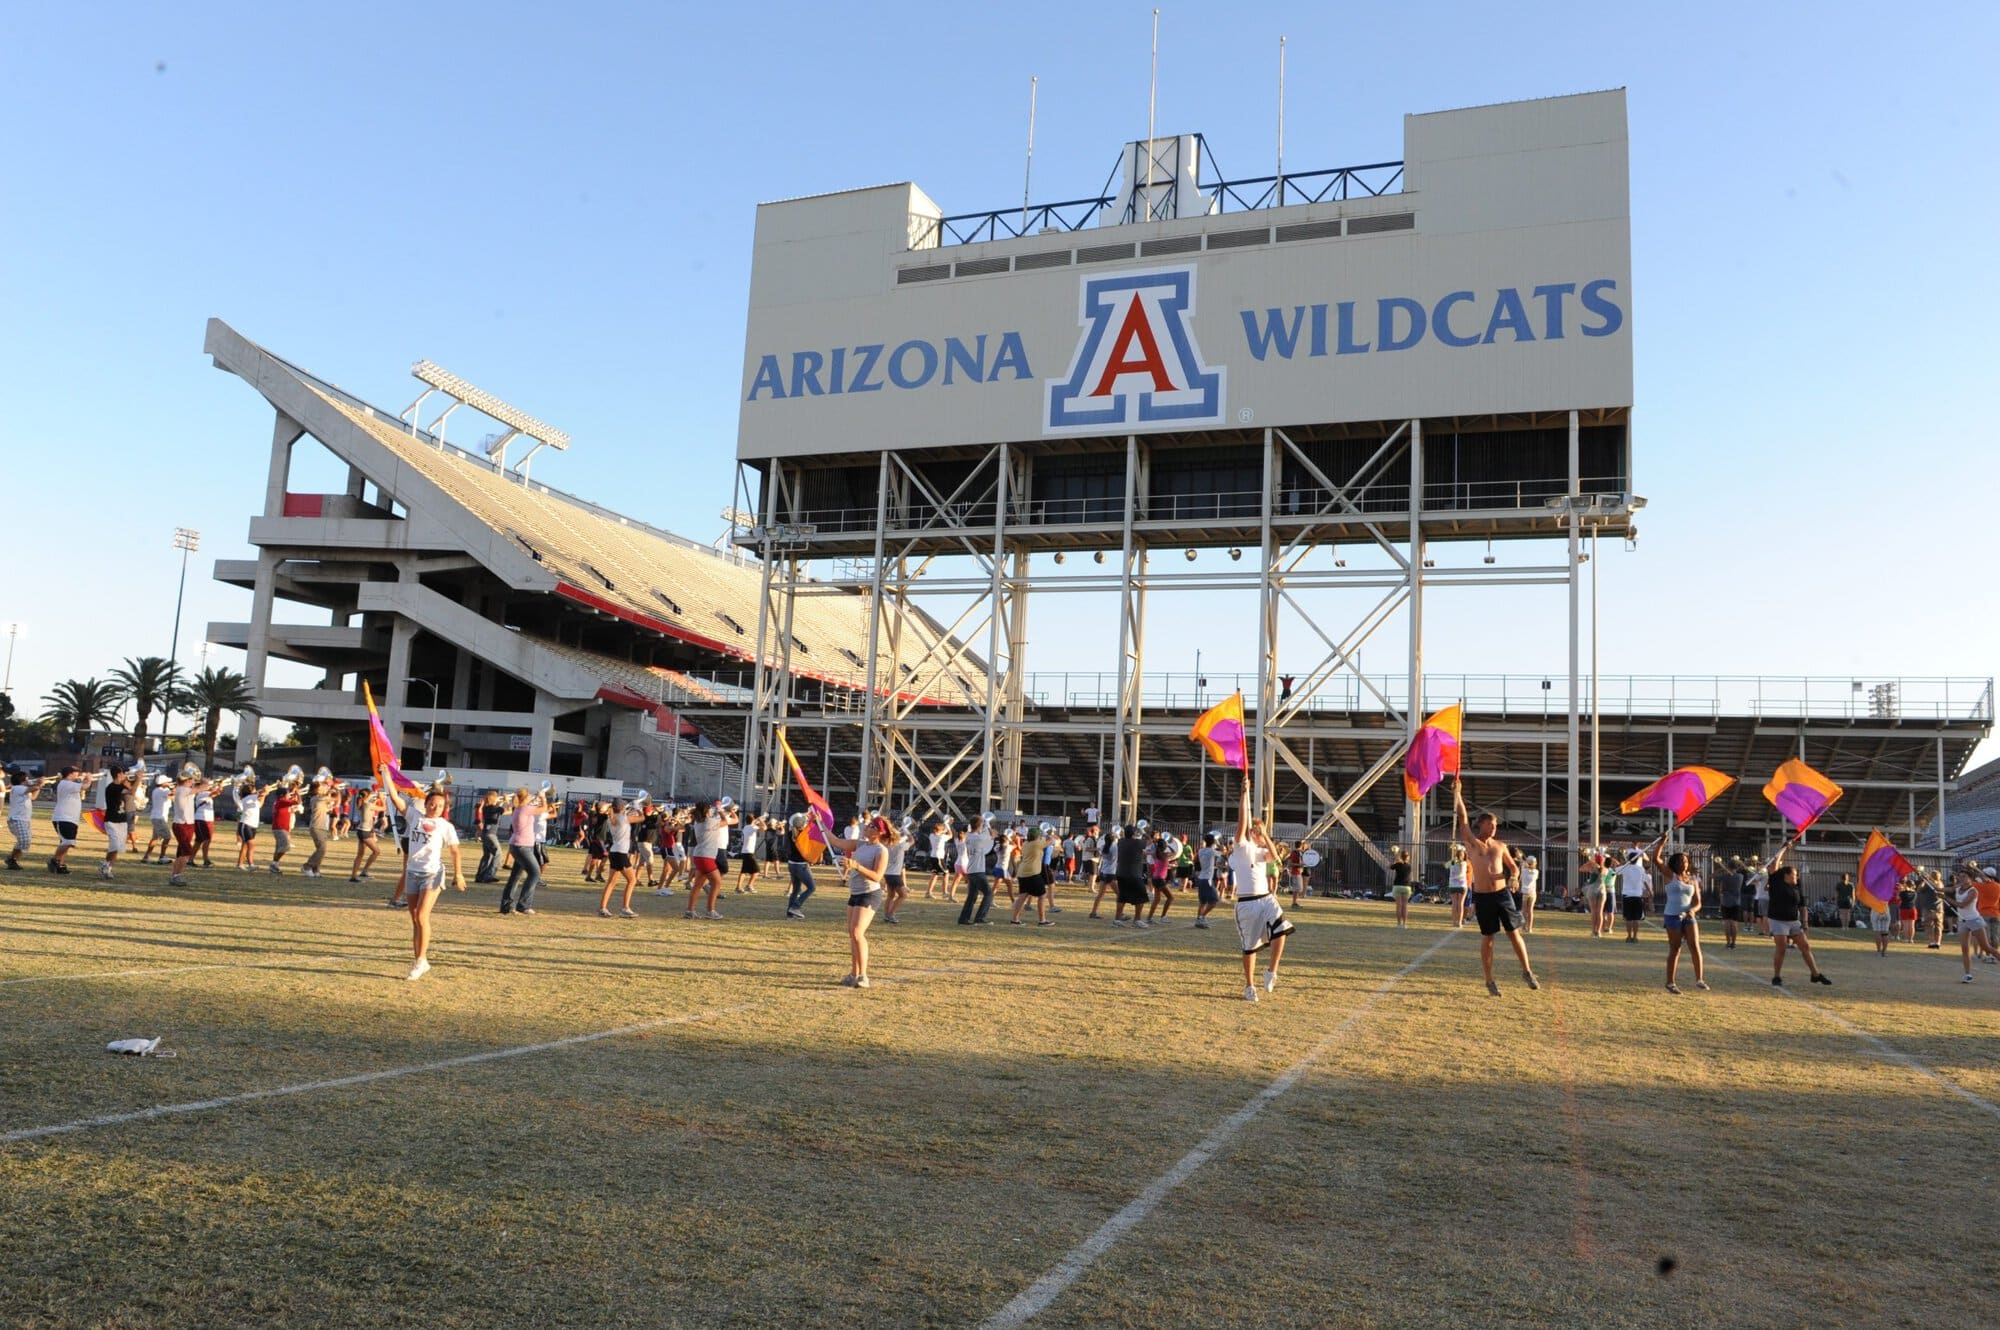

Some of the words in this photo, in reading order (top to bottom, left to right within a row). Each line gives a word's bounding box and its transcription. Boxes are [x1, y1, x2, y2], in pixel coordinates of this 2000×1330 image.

[747, 332, 1033, 400] ARIZONA
[1048, 269, 1222, 430] A
[1240, 279, 1623, 361] WILDCATS
[411, 830, 432, 844] NY
